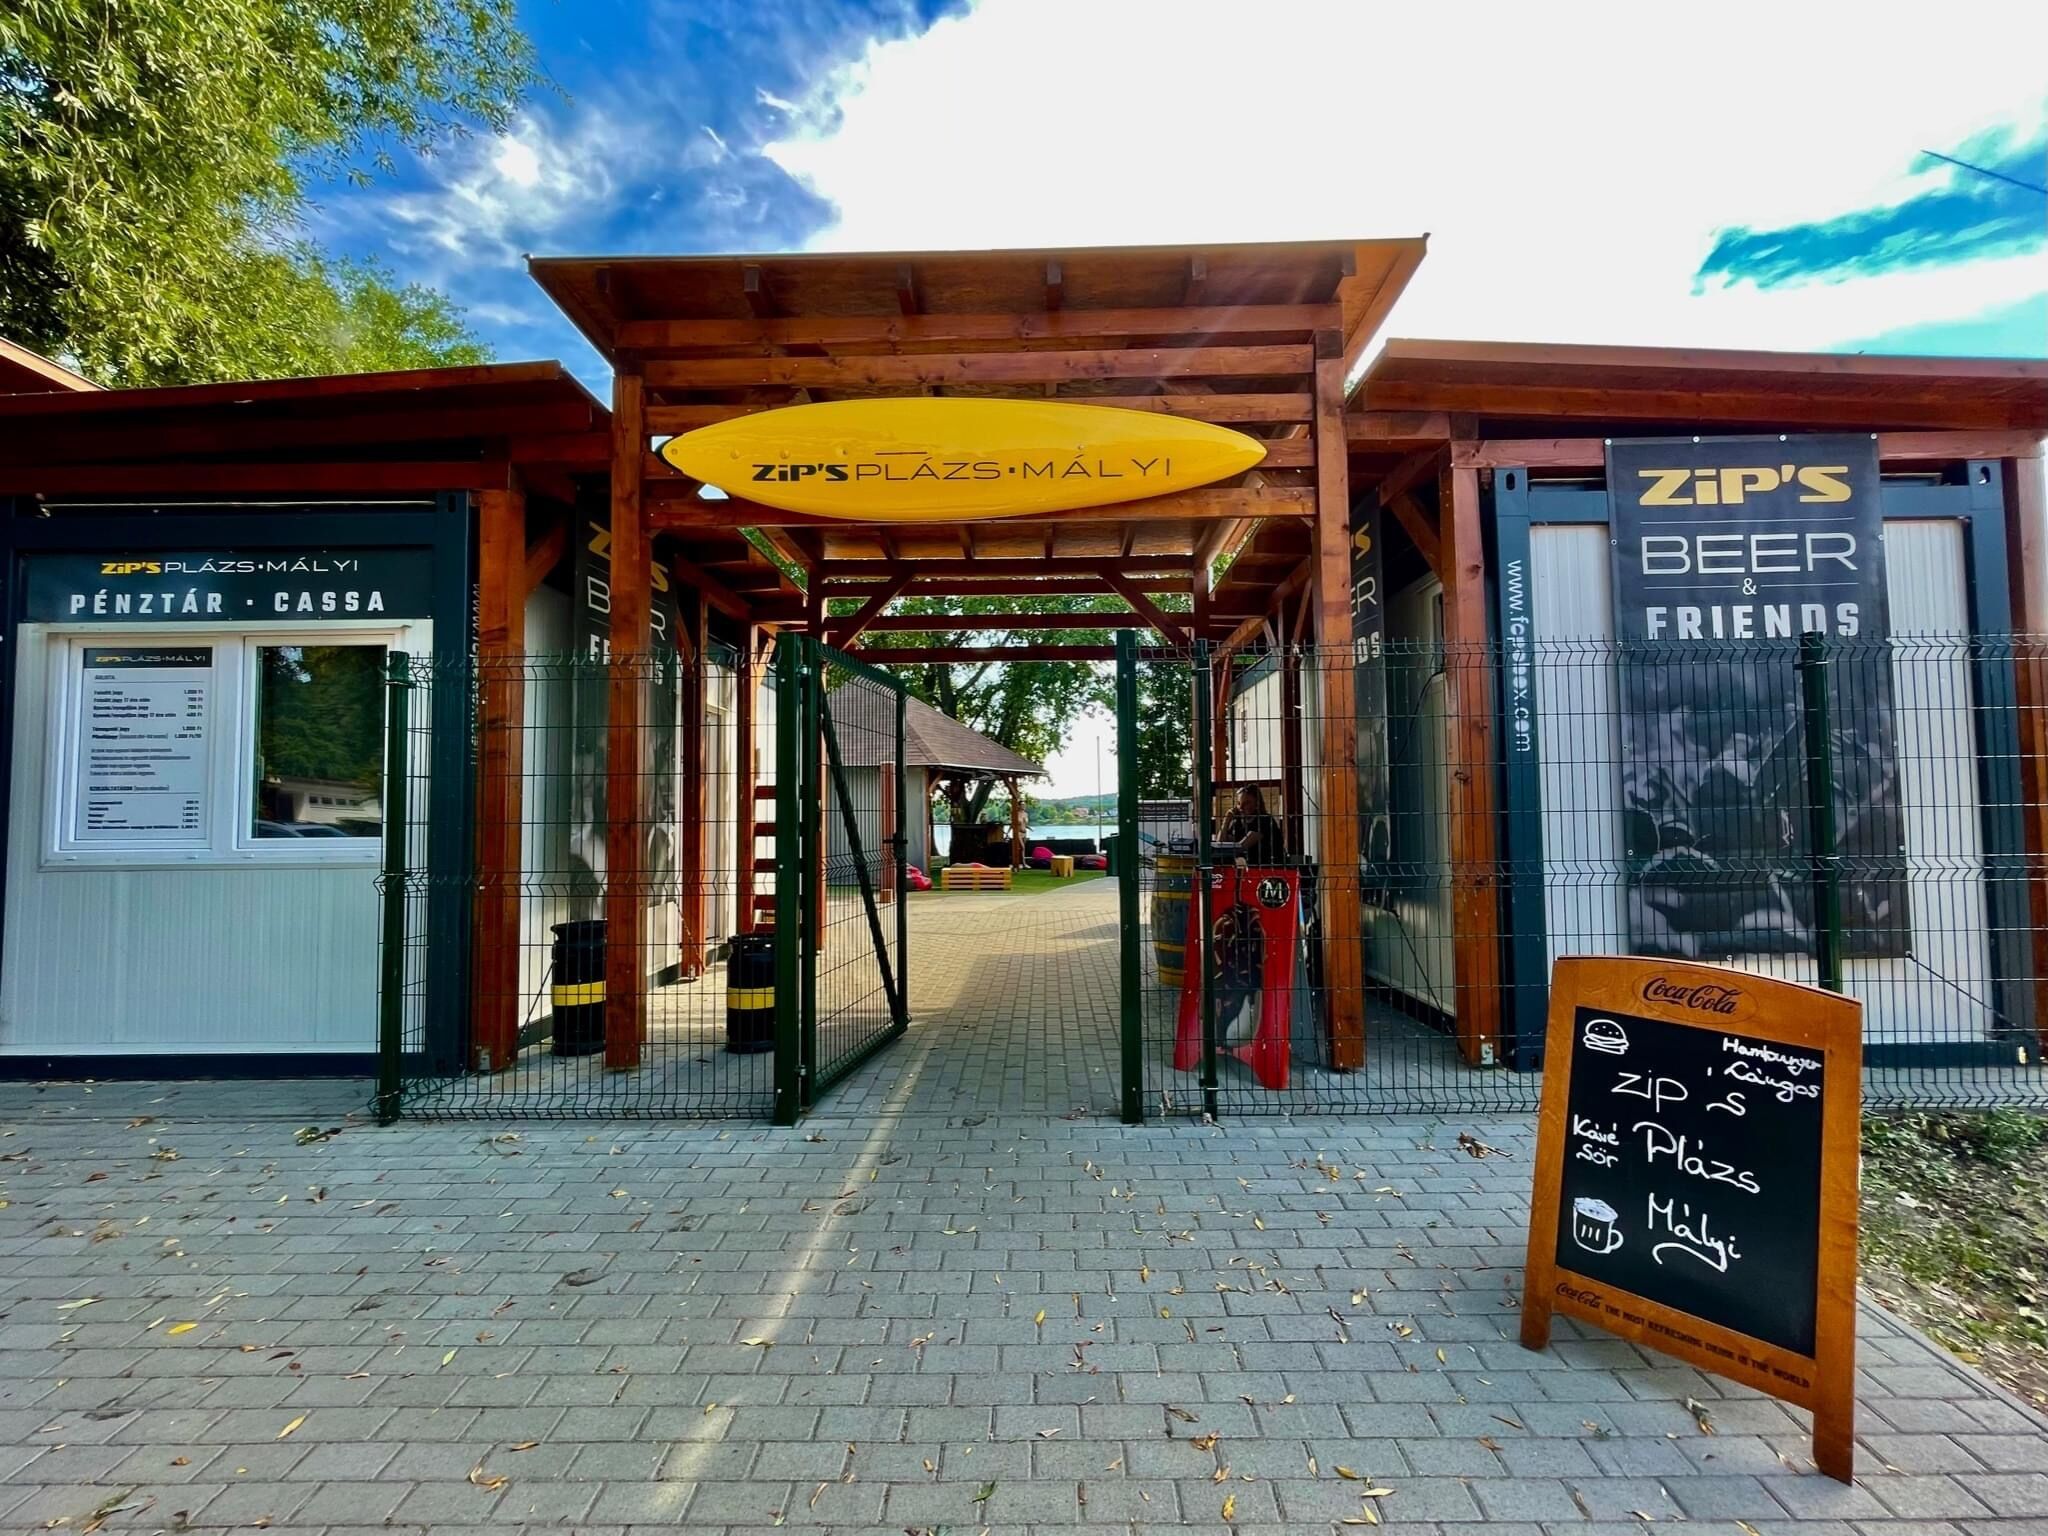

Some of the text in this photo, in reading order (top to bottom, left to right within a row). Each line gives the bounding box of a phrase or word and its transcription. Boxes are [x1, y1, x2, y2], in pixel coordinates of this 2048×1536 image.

[1641, 533, 1859, 575] BEER
[70, 588, 385, 615] PÉNZTÁR CASSA
[1742, 578, 1757, 595] &
[1646, 602, 1860, 641] FRIENDS
[1643, 977, 1743, 1015] Coca-Cola
[1722, 1037, 1822, 1076] Hamburger
[1632, 1121, 1761, 1194] Plázs
[1648, 1192, 1742, 1273] Mályi
[1556, 1282, 1602, 1308] Coca-Cola
[1605, 1304, 1621, 1318] THE
[1623, 1311, 1645, 1327] MOST
[1648, 1320, 1703, 1348] REFRESHING
[1751, 1358, 1769, 1372] THE
[1773, 1367, 1810, 1389] WORLD
